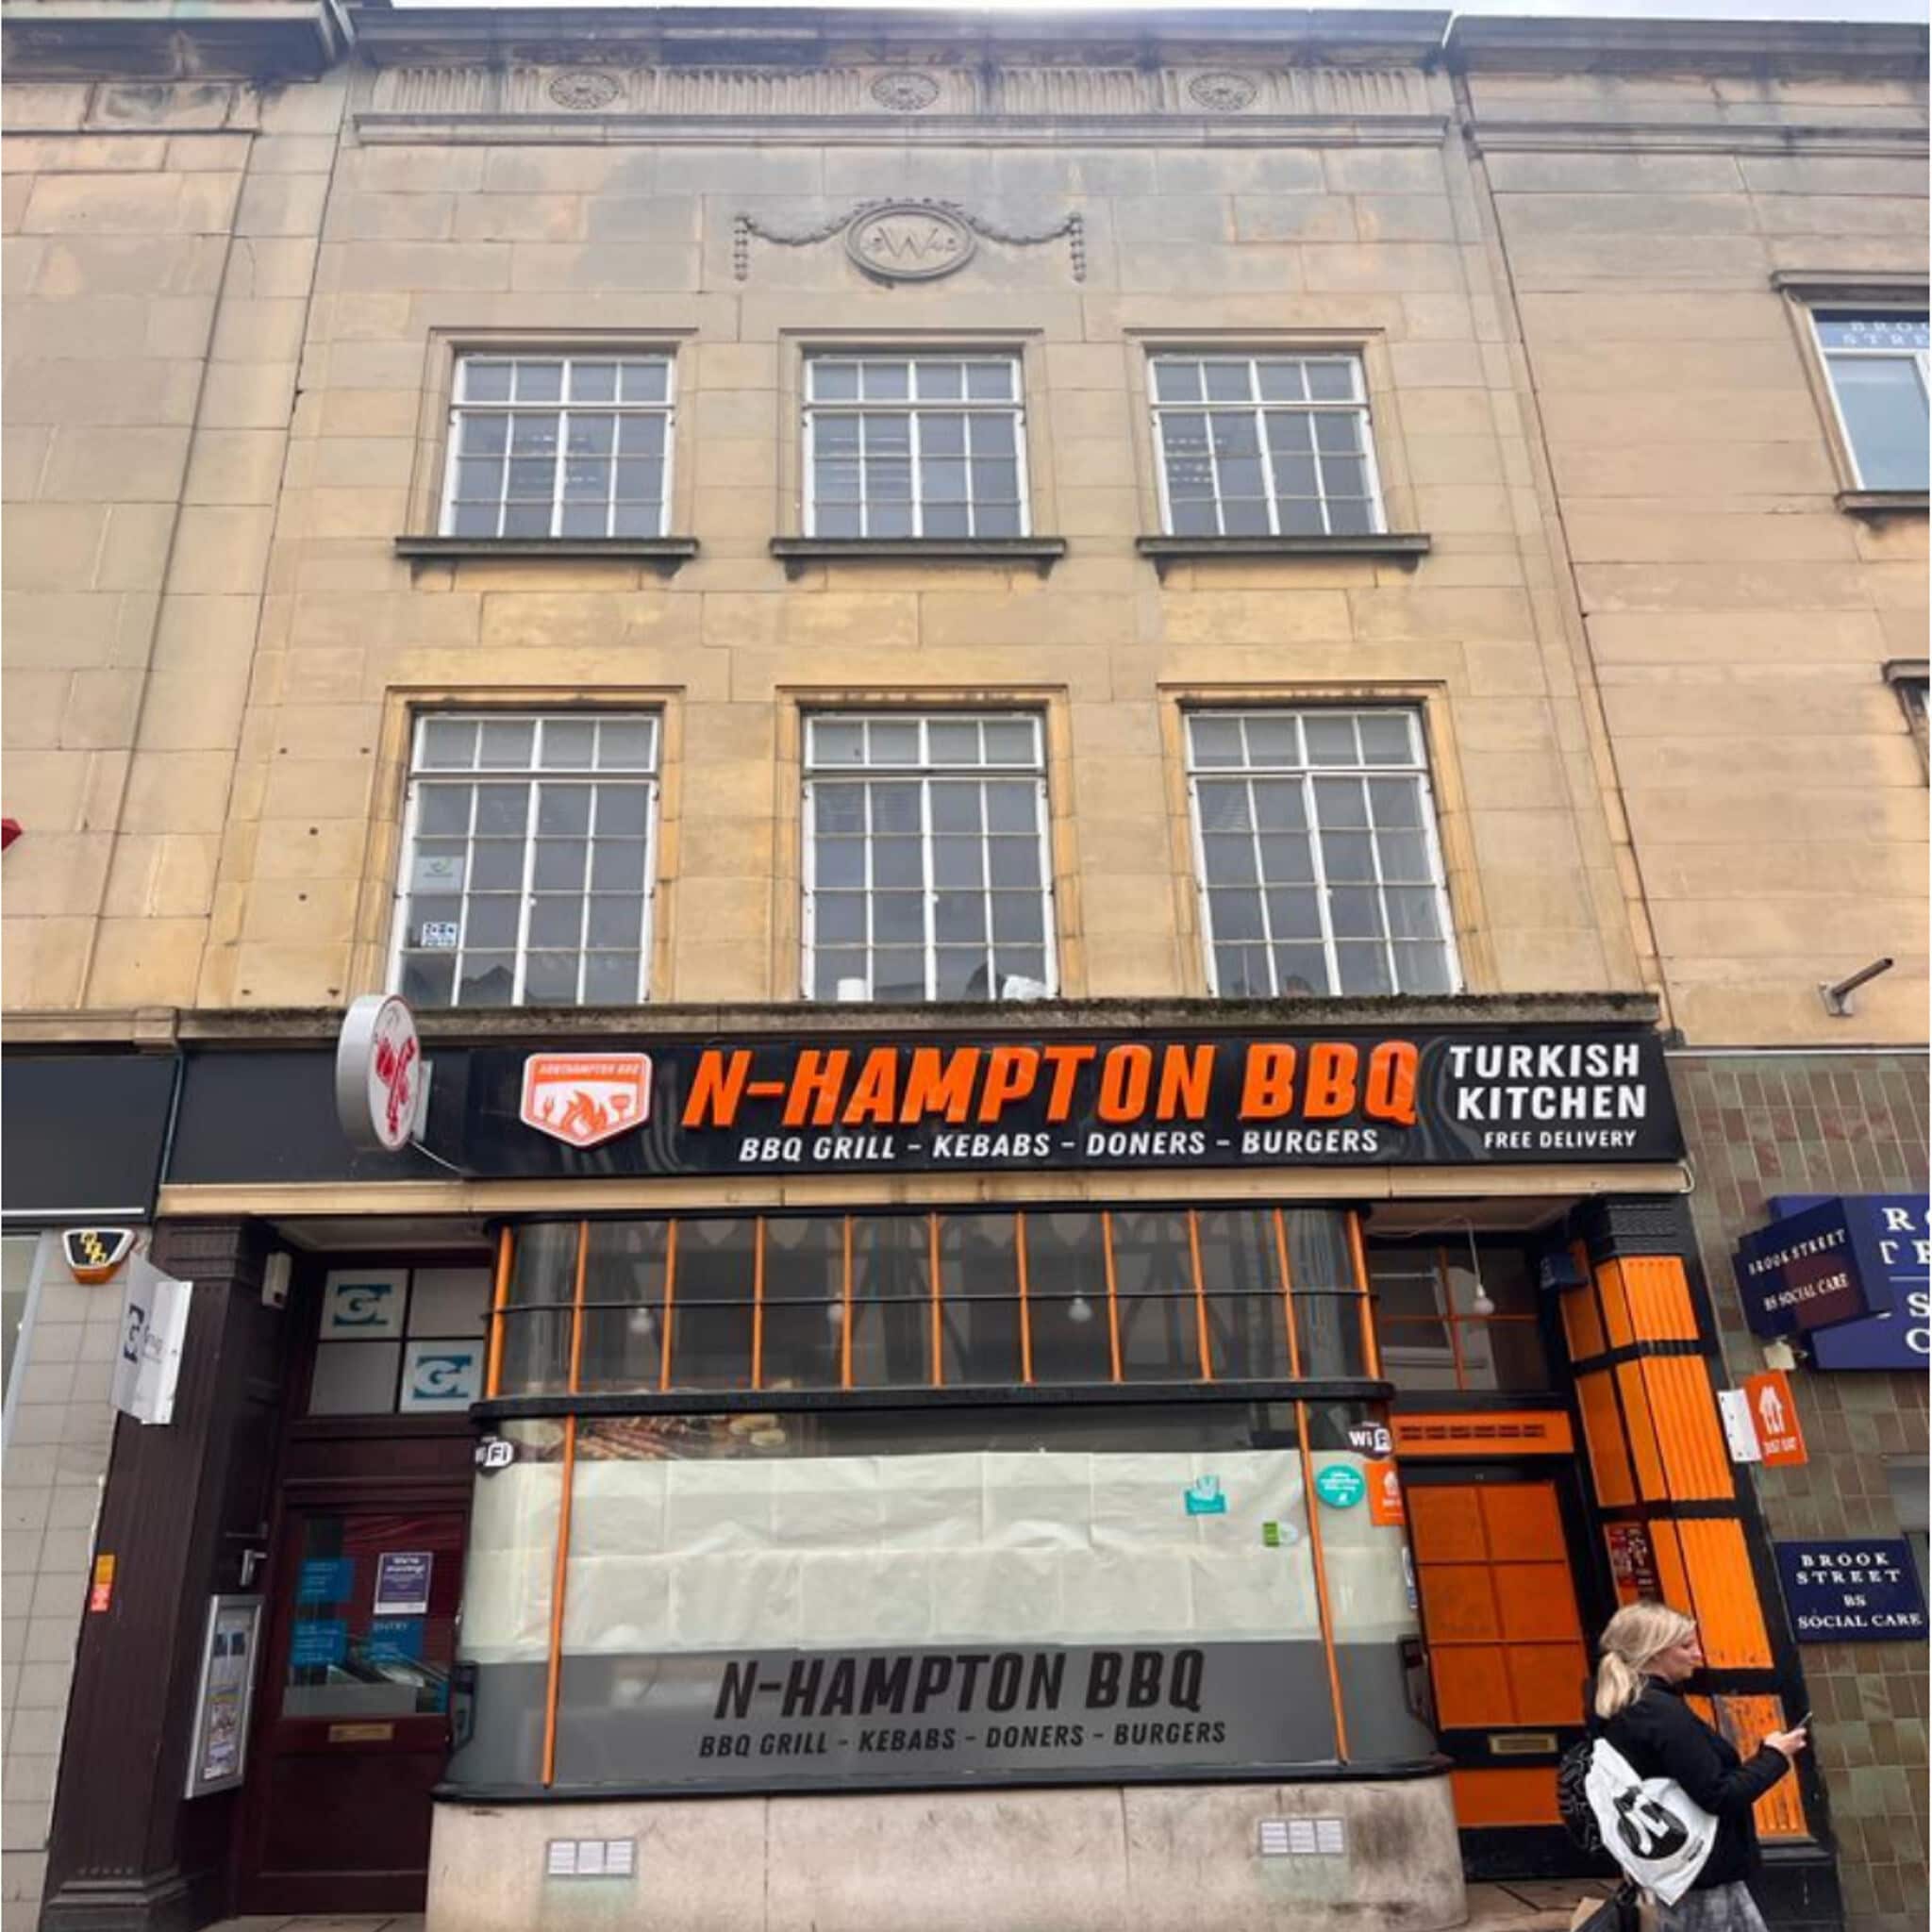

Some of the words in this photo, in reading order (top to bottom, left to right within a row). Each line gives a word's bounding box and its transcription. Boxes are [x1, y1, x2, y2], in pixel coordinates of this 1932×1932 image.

[1449, 1043, 1640, 1079] TURKISH
[681, 1044, 1217, 1127] N-HAMPTON
[1239, 1041, 1419, 1126] BBQ
[1457, 1085, 1646, 1120] KITCHEN
[739, 1137, 802, 1162] BBQ
[813, 1136, 895, 1159] GRILL
[932, 1133, 1051, 1158] KEBABS
[1087, 1131, 1207, 1156] DONERS
[1241, 1129, 1379, 1154] BURGERS
[1484, 1131, 1533, 1149] FREE
[1540, 1130, 1638, 1147] DELIVERY
[1791, 1228, 1846, 1258] STREET
[1779, 1284, 1817, 1306] SOCIAL
[1818, 1273, 1851, 1296] CARE
[1801, 1552, 1890, 1568] BROOK
[1796, 1570, 1901, 1586] STREET
[1842, 1592, 1867, 1607] BS
[1798, 1614, 1868, 1630] SOCIAL
[1872, 1612, 1924, 1628] CARE
[714, 1652, 1067, 1720] N-HAMPTON
[1085, 1649, 1205, 1712] BBQ
[698, 1734, 751, 1759] BBQ
[759, 1731, 828, 1757] GRILL
[858, 1727, 957, 1753] KEBABS
[986, 1724, 1085, 1748] DONERS
[1113, 1722, 1225, 1745] BURGERS
